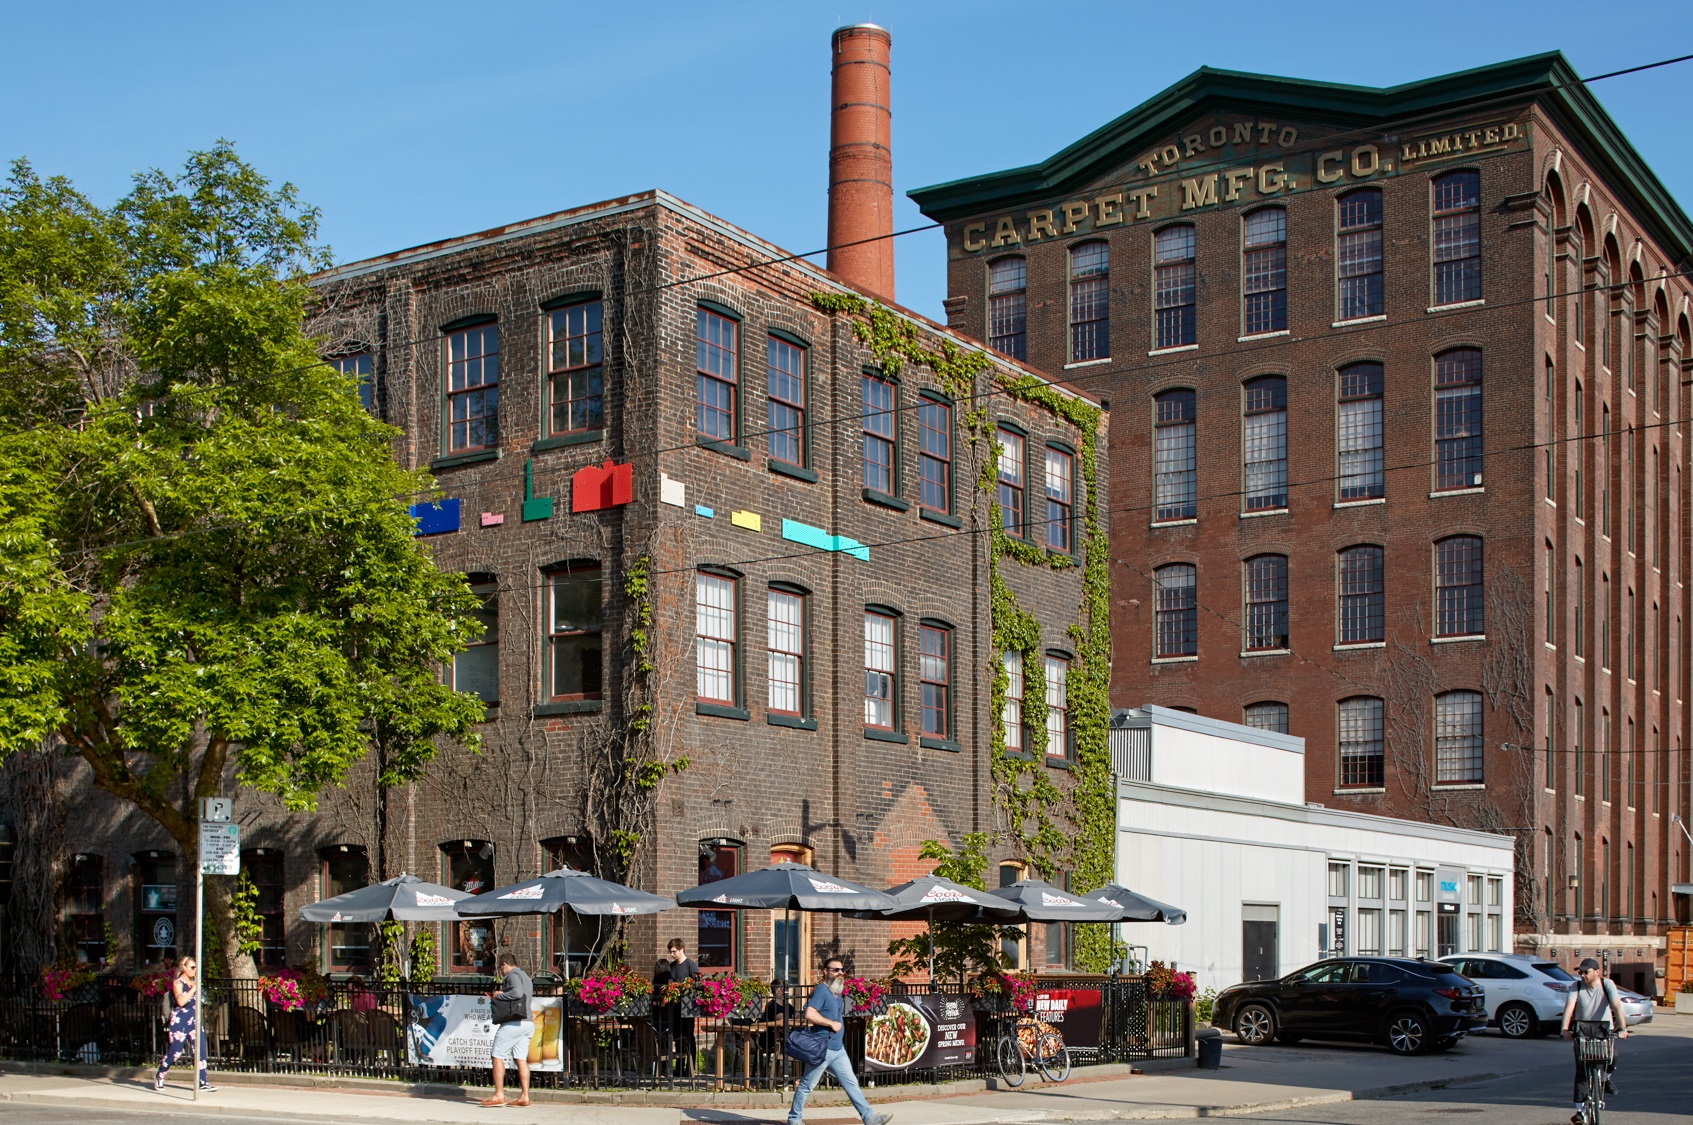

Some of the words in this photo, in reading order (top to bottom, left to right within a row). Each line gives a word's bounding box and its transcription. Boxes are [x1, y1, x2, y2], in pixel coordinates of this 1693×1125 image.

[1138, 121, 1298, 177] TORONTO
[963, 185, 1158, 252] CARPET
[1181, 161, 1297, 210] MFG.
[1316, 144, 1392, 184] CO.
[462, 880, 485, 892] Miller
[925, 889, 965, 898] Coors
[1035, 999, 1050, 1011] NEW
[1050, 999, 1069, 1011] DAILY
[1040, 1010, 1065, 1023] FEATURES
[945, 1031, 958, 1040] NEW
[448, 1037, 468, 1046] CATCH
[469, 1038, 493, 1047] STANLE
[937, 1040, 952, 1048] SPRING
[446, 1046, 473, 1055] PLAYOFF
